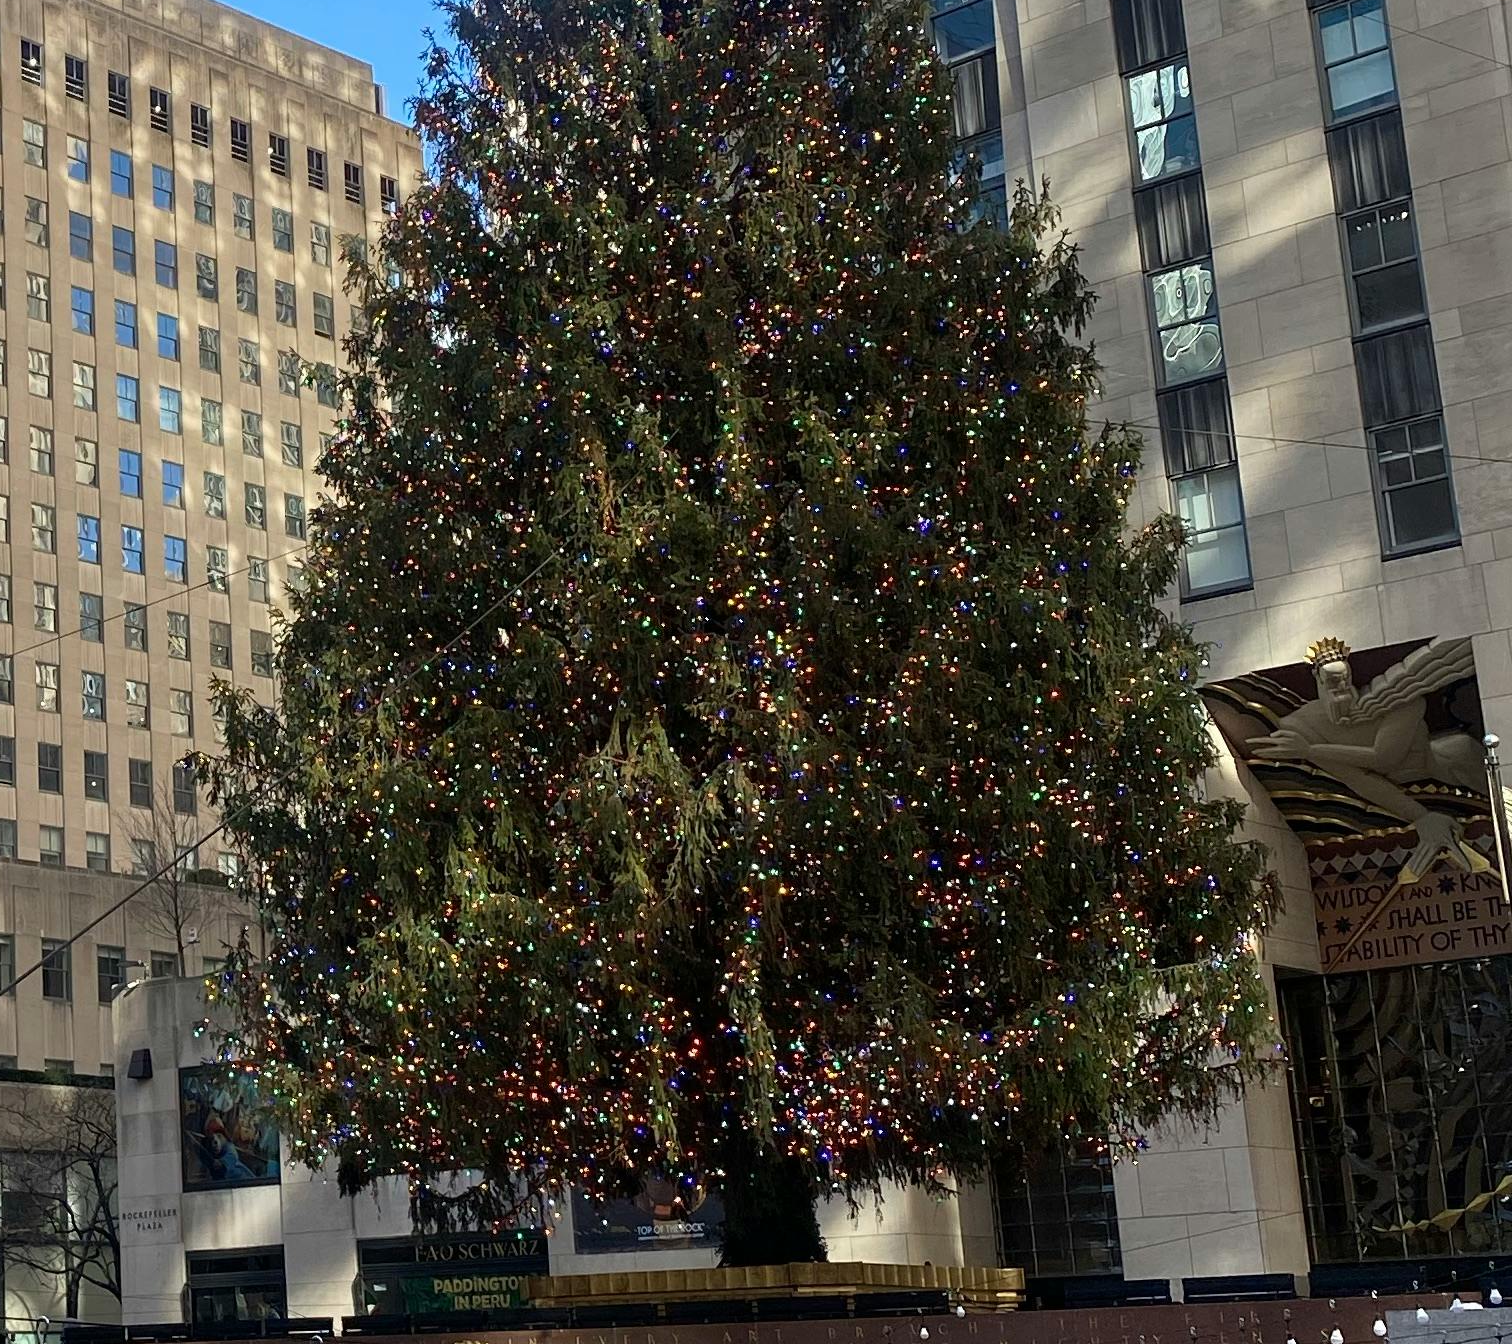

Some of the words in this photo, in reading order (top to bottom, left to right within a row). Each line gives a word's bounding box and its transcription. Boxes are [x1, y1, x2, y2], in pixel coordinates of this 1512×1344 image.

[1409, 886, 1433, 901] AND
[1386, 904, 1448, 930] SHALL
[1452, 899, 1477, 923] BE
[1320, 932, 1424, 964] STABILITY
[1431, 928, 1462, 951] OF
[1466, 922, 1512, 948] THY
[122, 1208, 177, 1221] ROCKEFELLER
[136, 1222, 163, 1232] PLAZA
[637, 1225, 652, 1236] TOP
[458, 1239, 539, 1260] SCHWARZ
[454, 1295, 470, 1311] IN
[472, 1292, 510, 1309] PERU
